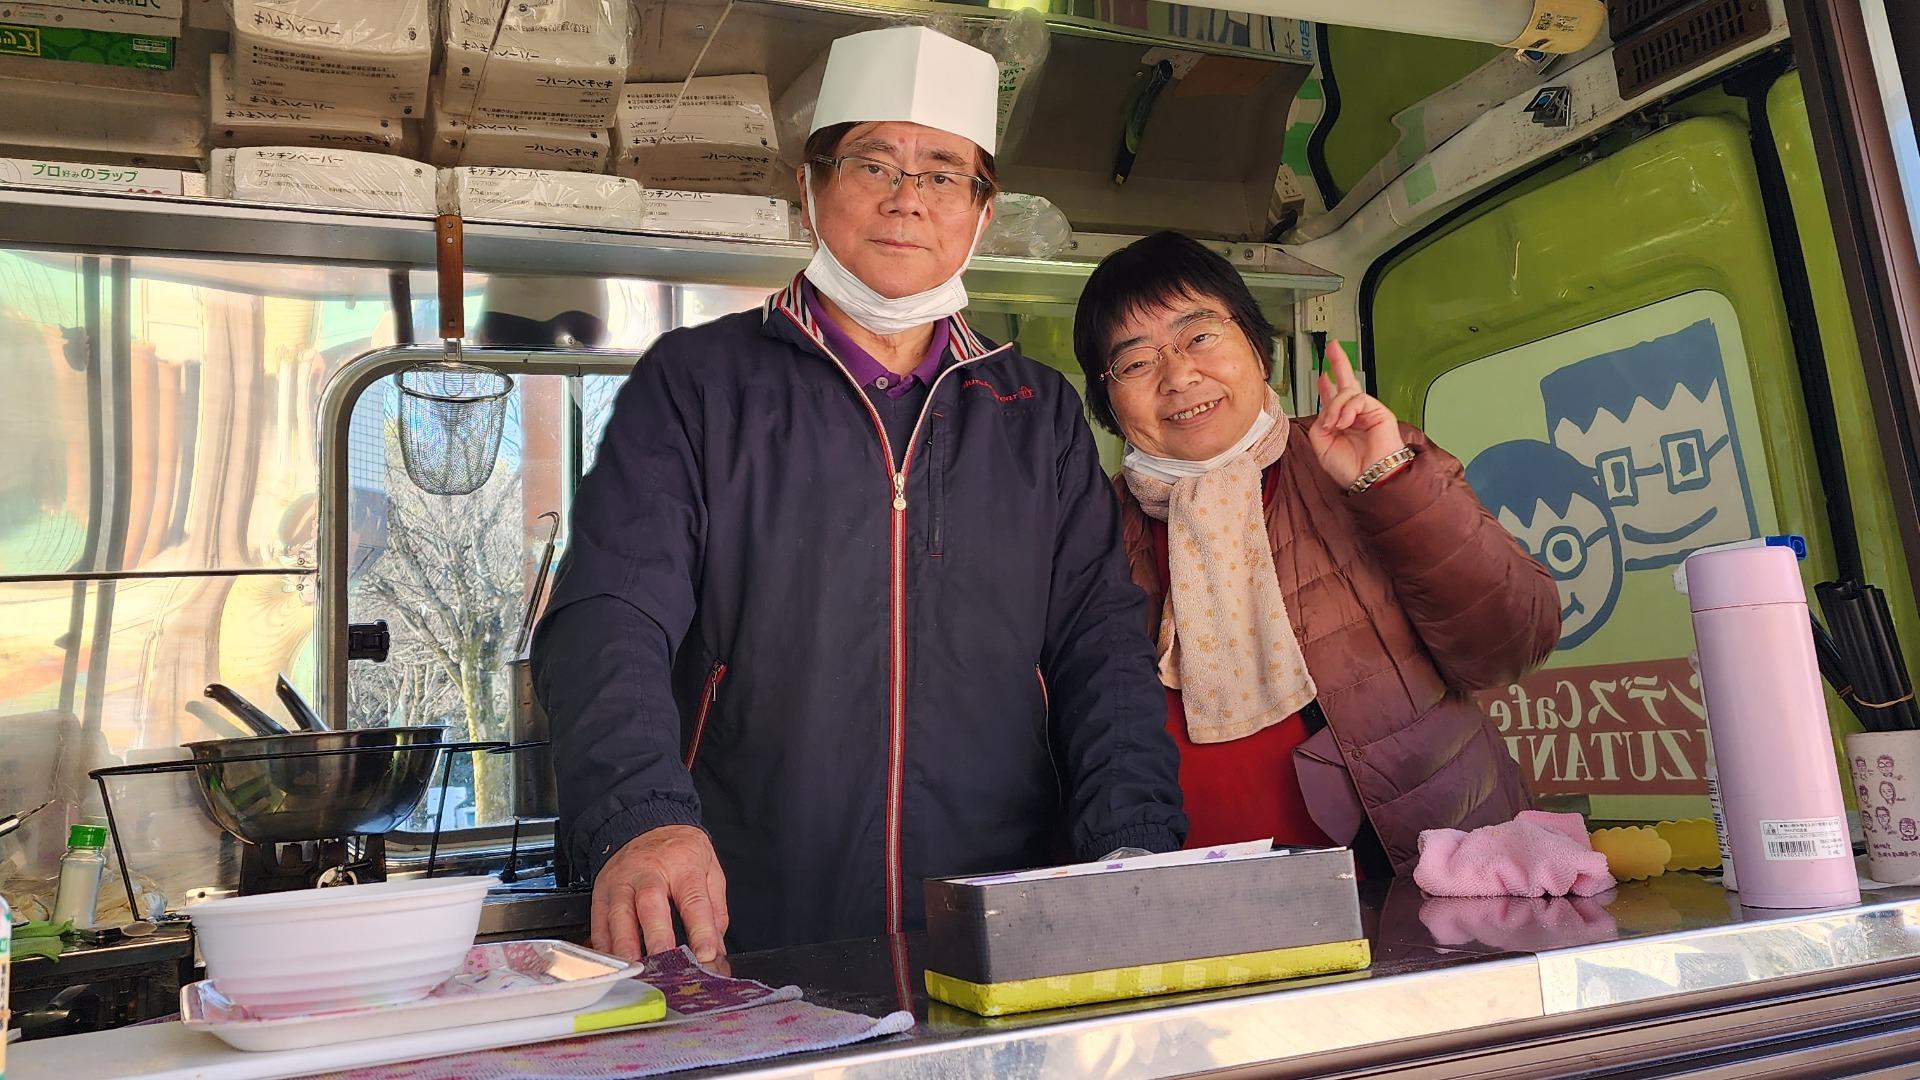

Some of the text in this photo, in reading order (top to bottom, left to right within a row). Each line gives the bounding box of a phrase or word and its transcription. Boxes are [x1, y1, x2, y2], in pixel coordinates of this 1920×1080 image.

[256, 150, 344, 165] キッチンペーパー
[31, 163, 139, 183] プロ好みのラップ
[467, 167, 549, 179] キッチンペーパー
